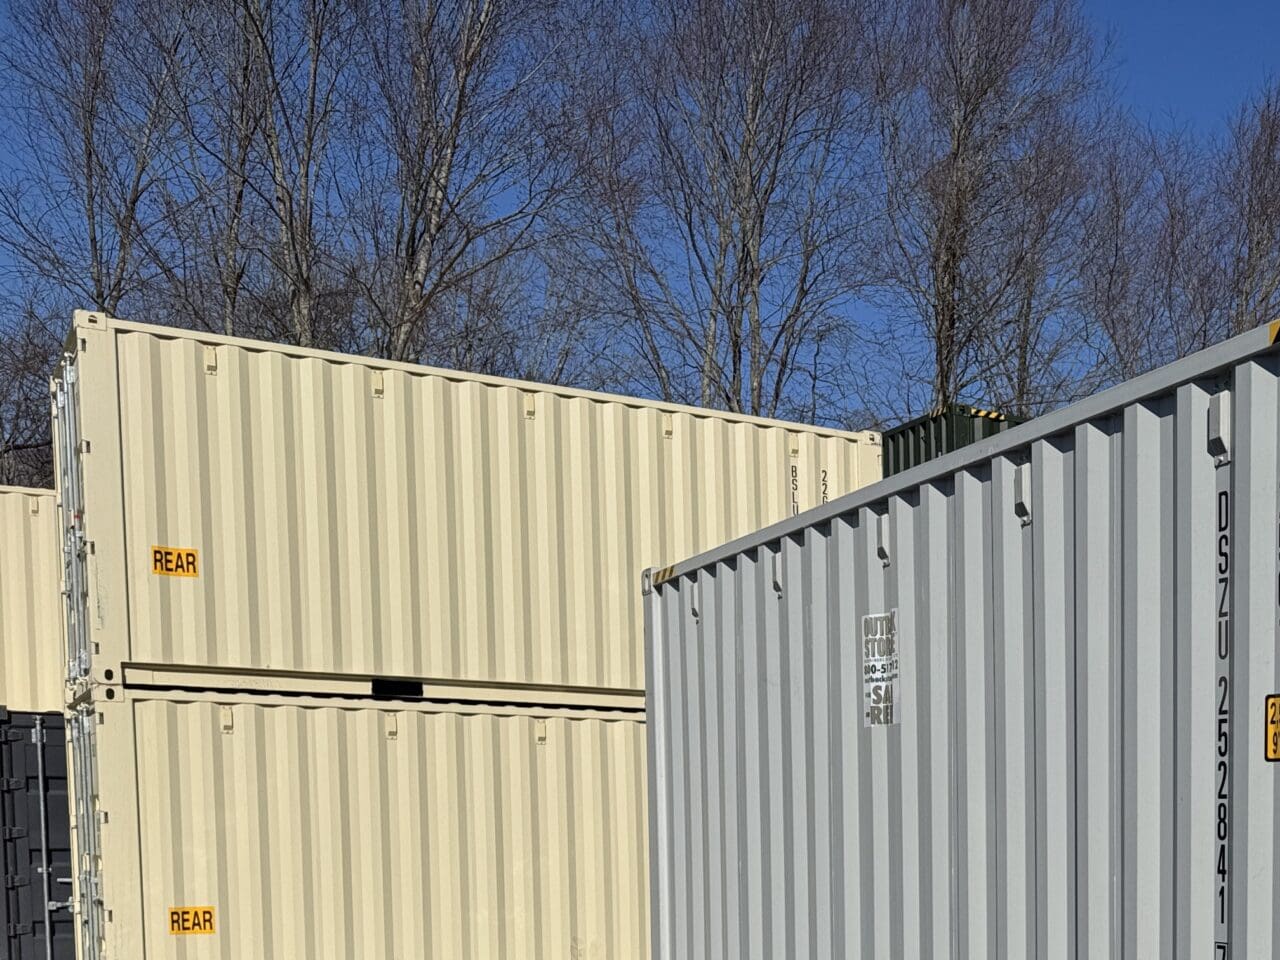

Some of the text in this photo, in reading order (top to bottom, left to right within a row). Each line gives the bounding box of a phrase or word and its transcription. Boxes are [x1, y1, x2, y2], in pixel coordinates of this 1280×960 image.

[153, 549, 197, 573] REAR
[1218, 490, 1229, 661] DSZU
[1217, 675, 1229, 925] 252841
[170, 910, 213, 931] REAR
